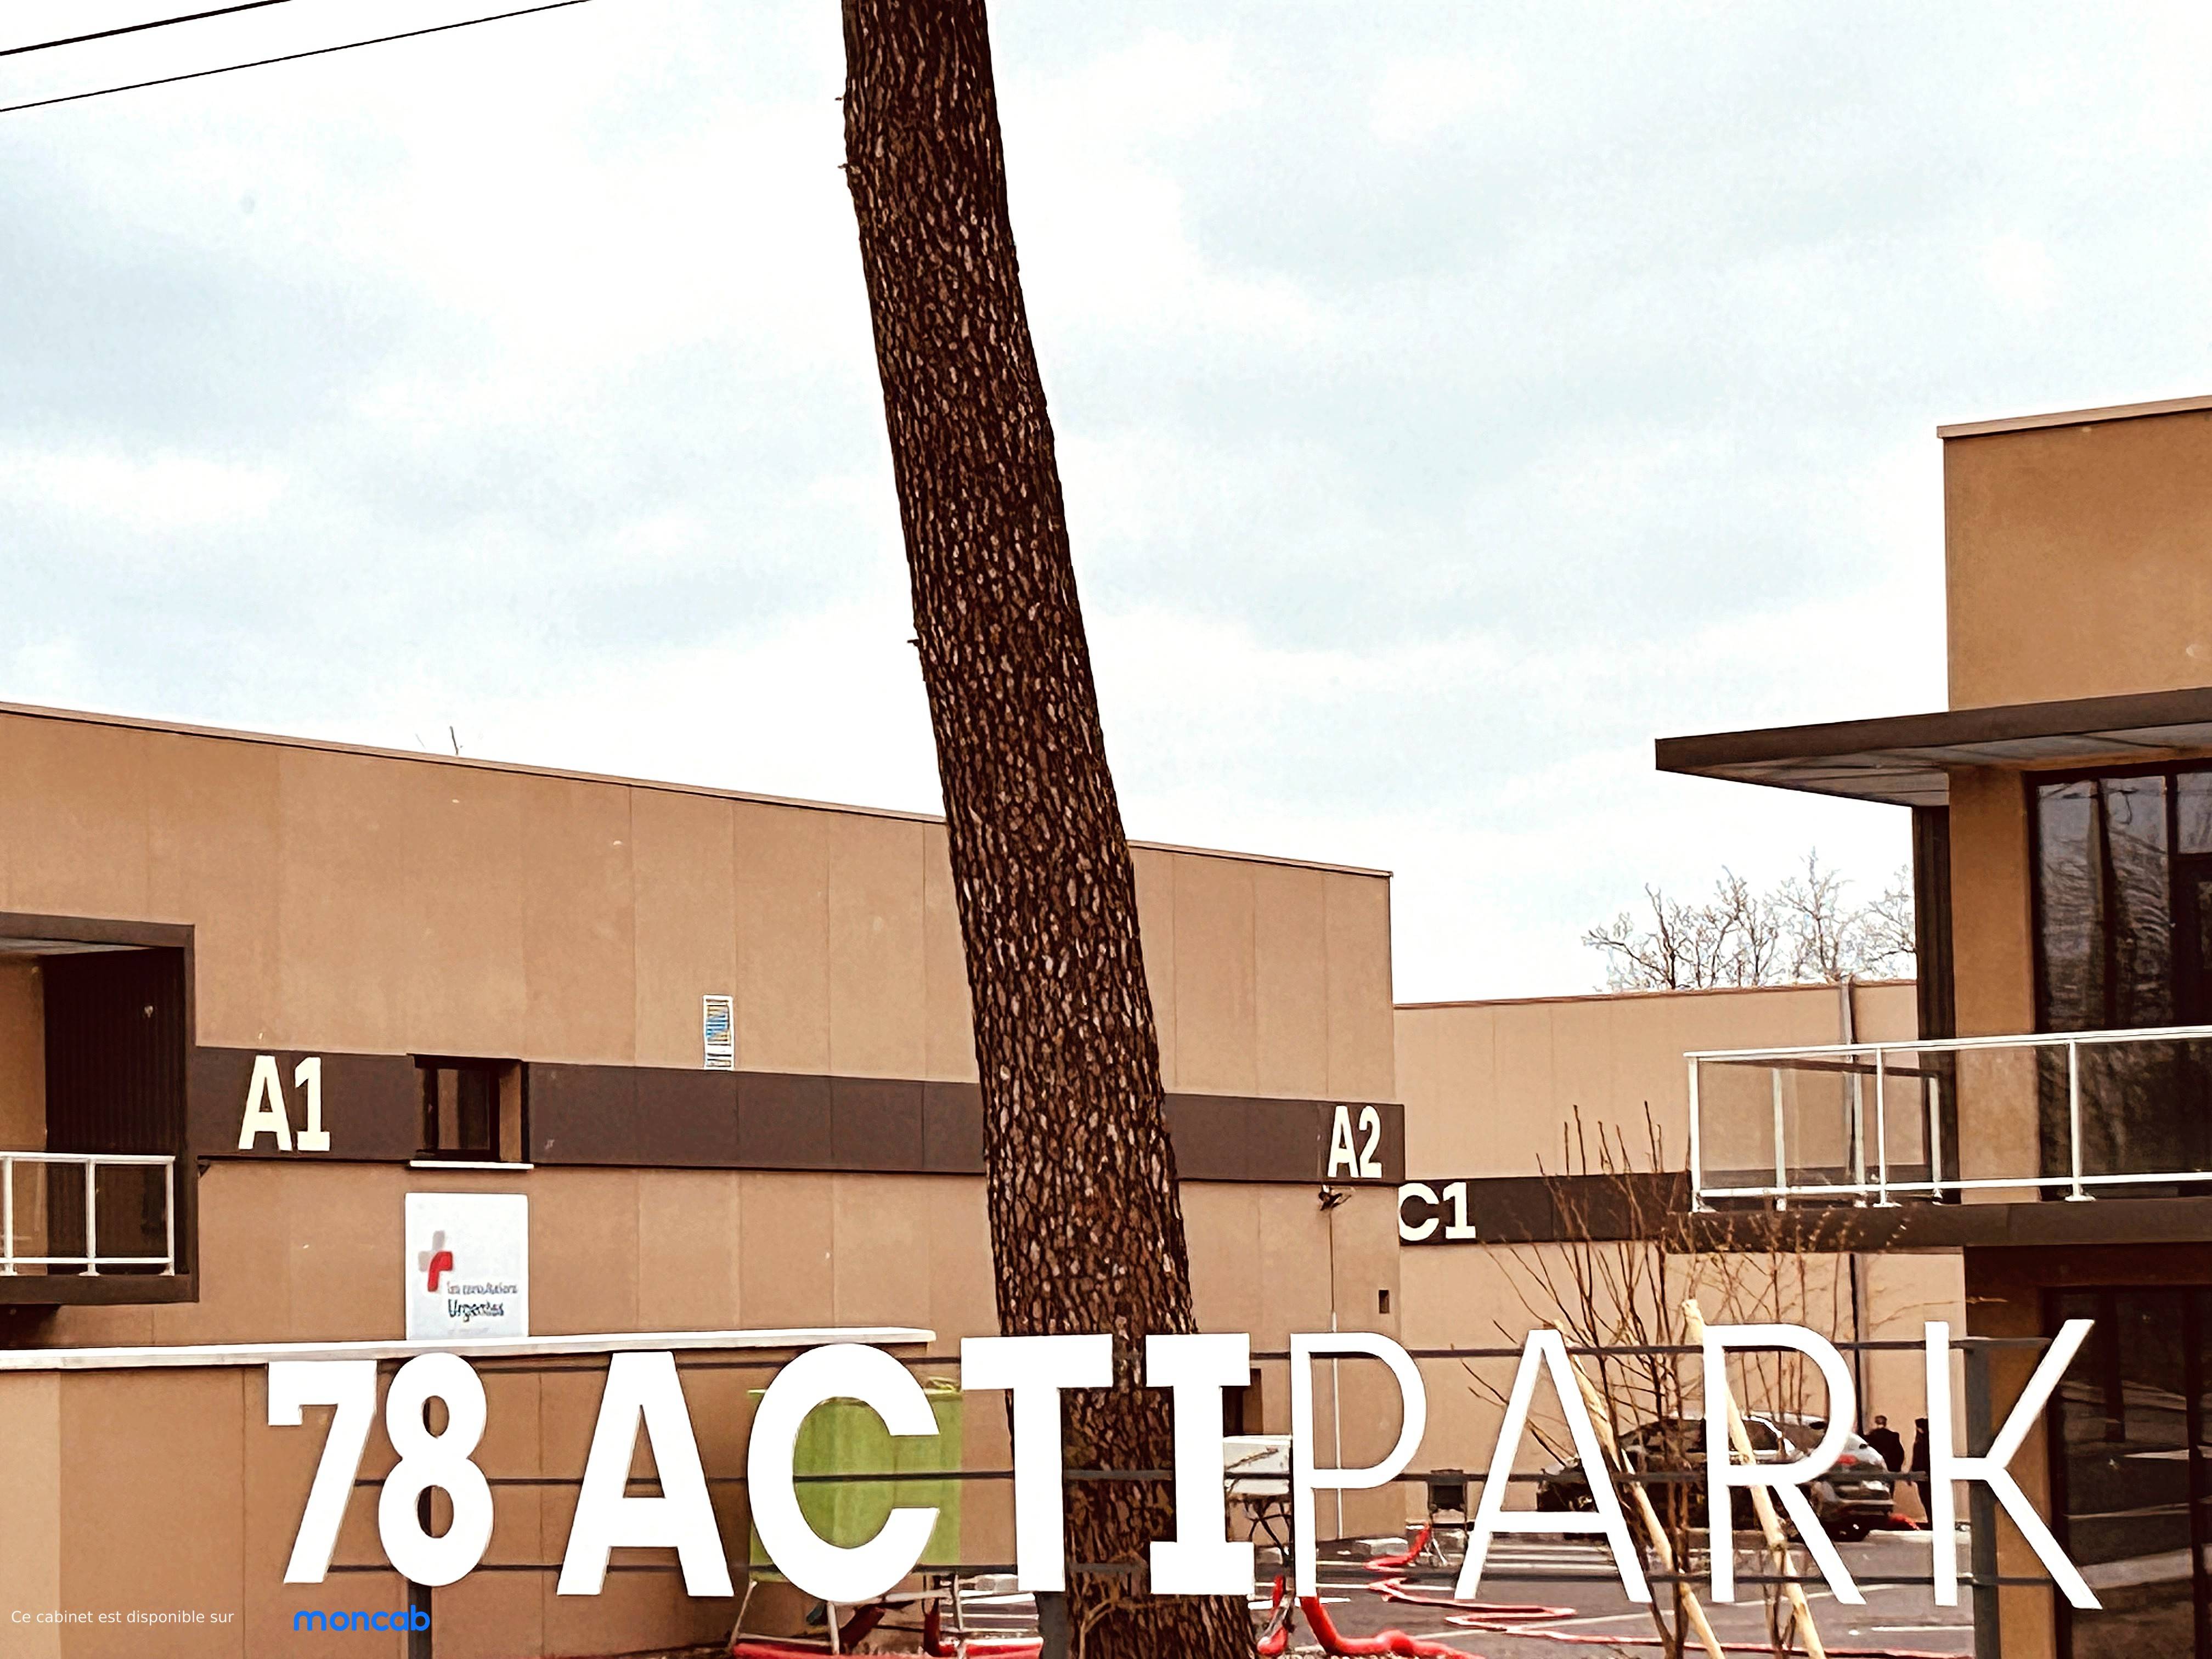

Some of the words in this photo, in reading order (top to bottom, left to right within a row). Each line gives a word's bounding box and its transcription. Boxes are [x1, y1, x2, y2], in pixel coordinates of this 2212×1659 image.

[238, 1055, 330, 1152] A1
[1327, 1105, 1383, 1179] A2
[1398, 1182, 1476, 1241] C1
[268, 1353, 492, 1585] 78
